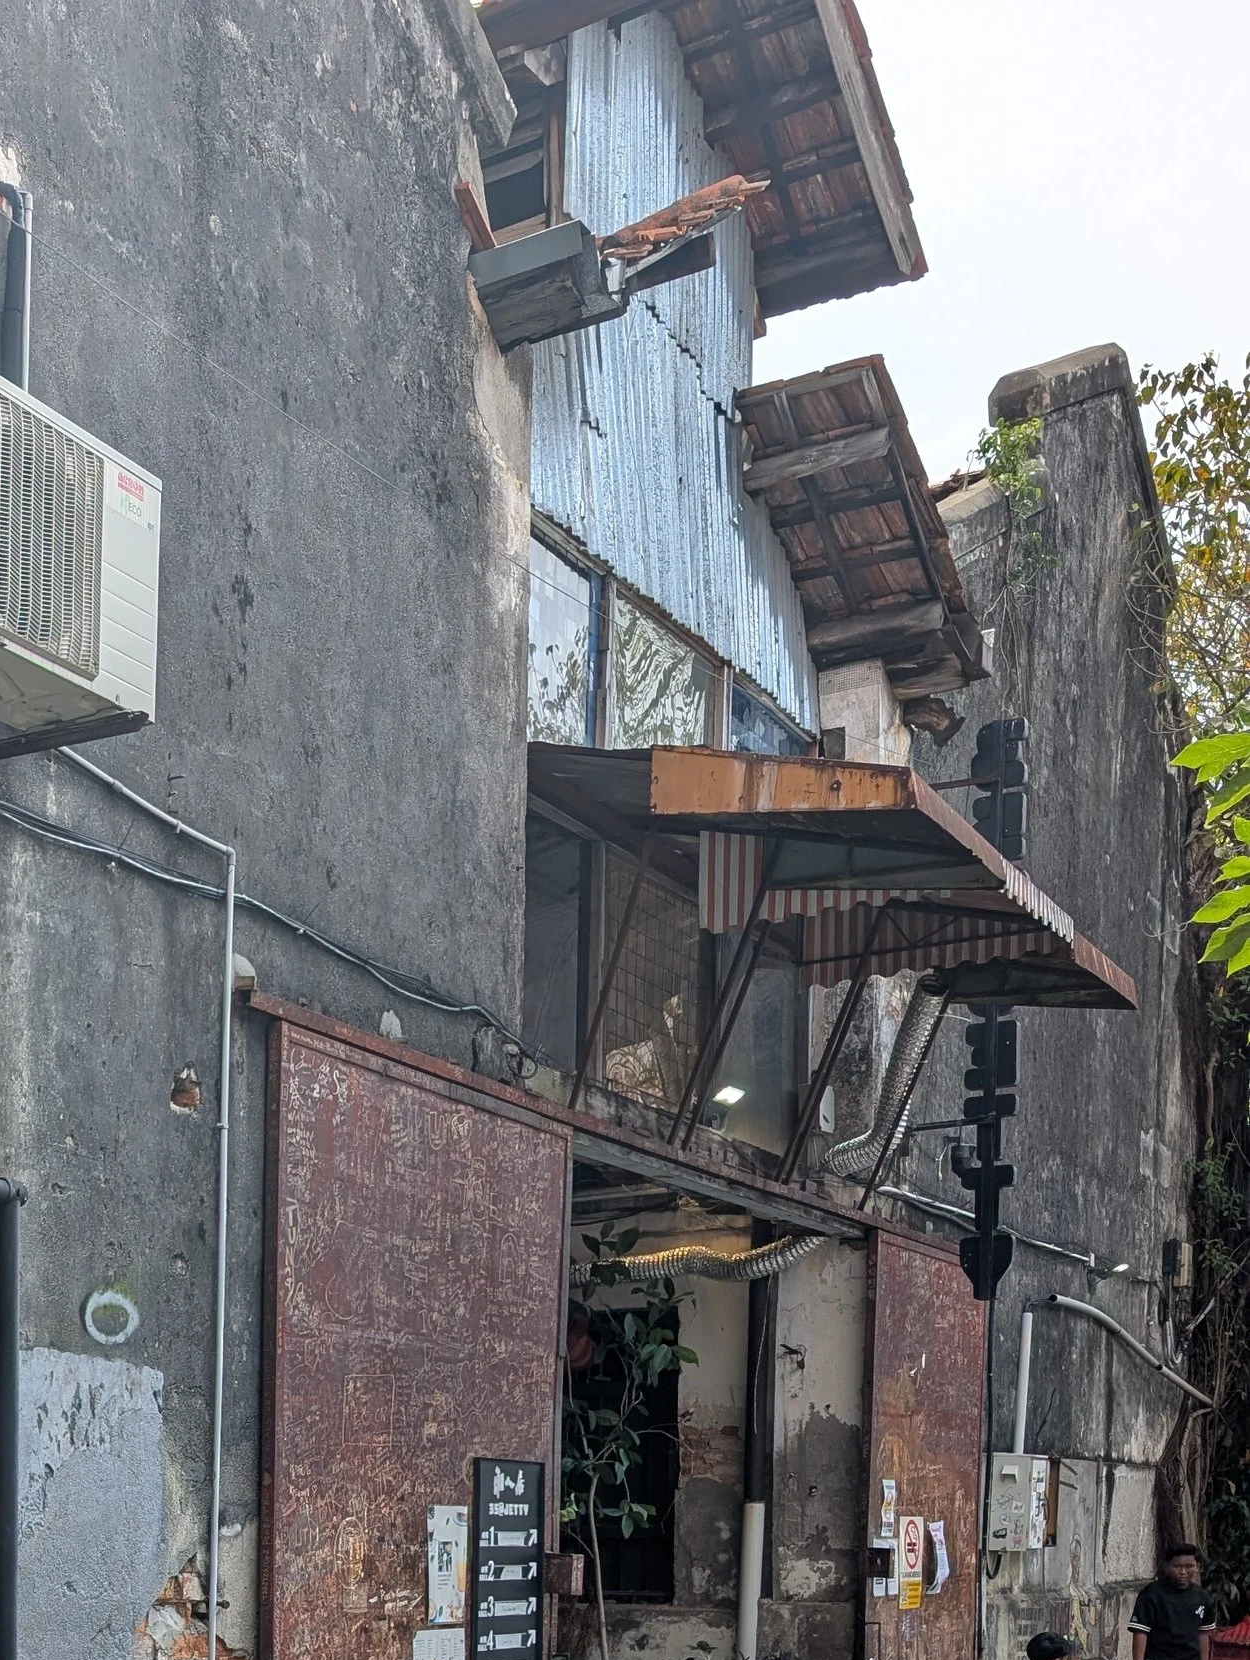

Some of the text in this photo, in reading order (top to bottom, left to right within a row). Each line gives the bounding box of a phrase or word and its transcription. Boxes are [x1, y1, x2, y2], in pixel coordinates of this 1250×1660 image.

[128, 502, 142, 517] ECO
[488, 1502, 529, 1516] 35@JETTY
[489, 1525, 495, 1547] 1
[487, 1560, 495, 1582] 2
[487, 1595, 494, 1617] 3
[486, 1629, 494, 1651] 4
